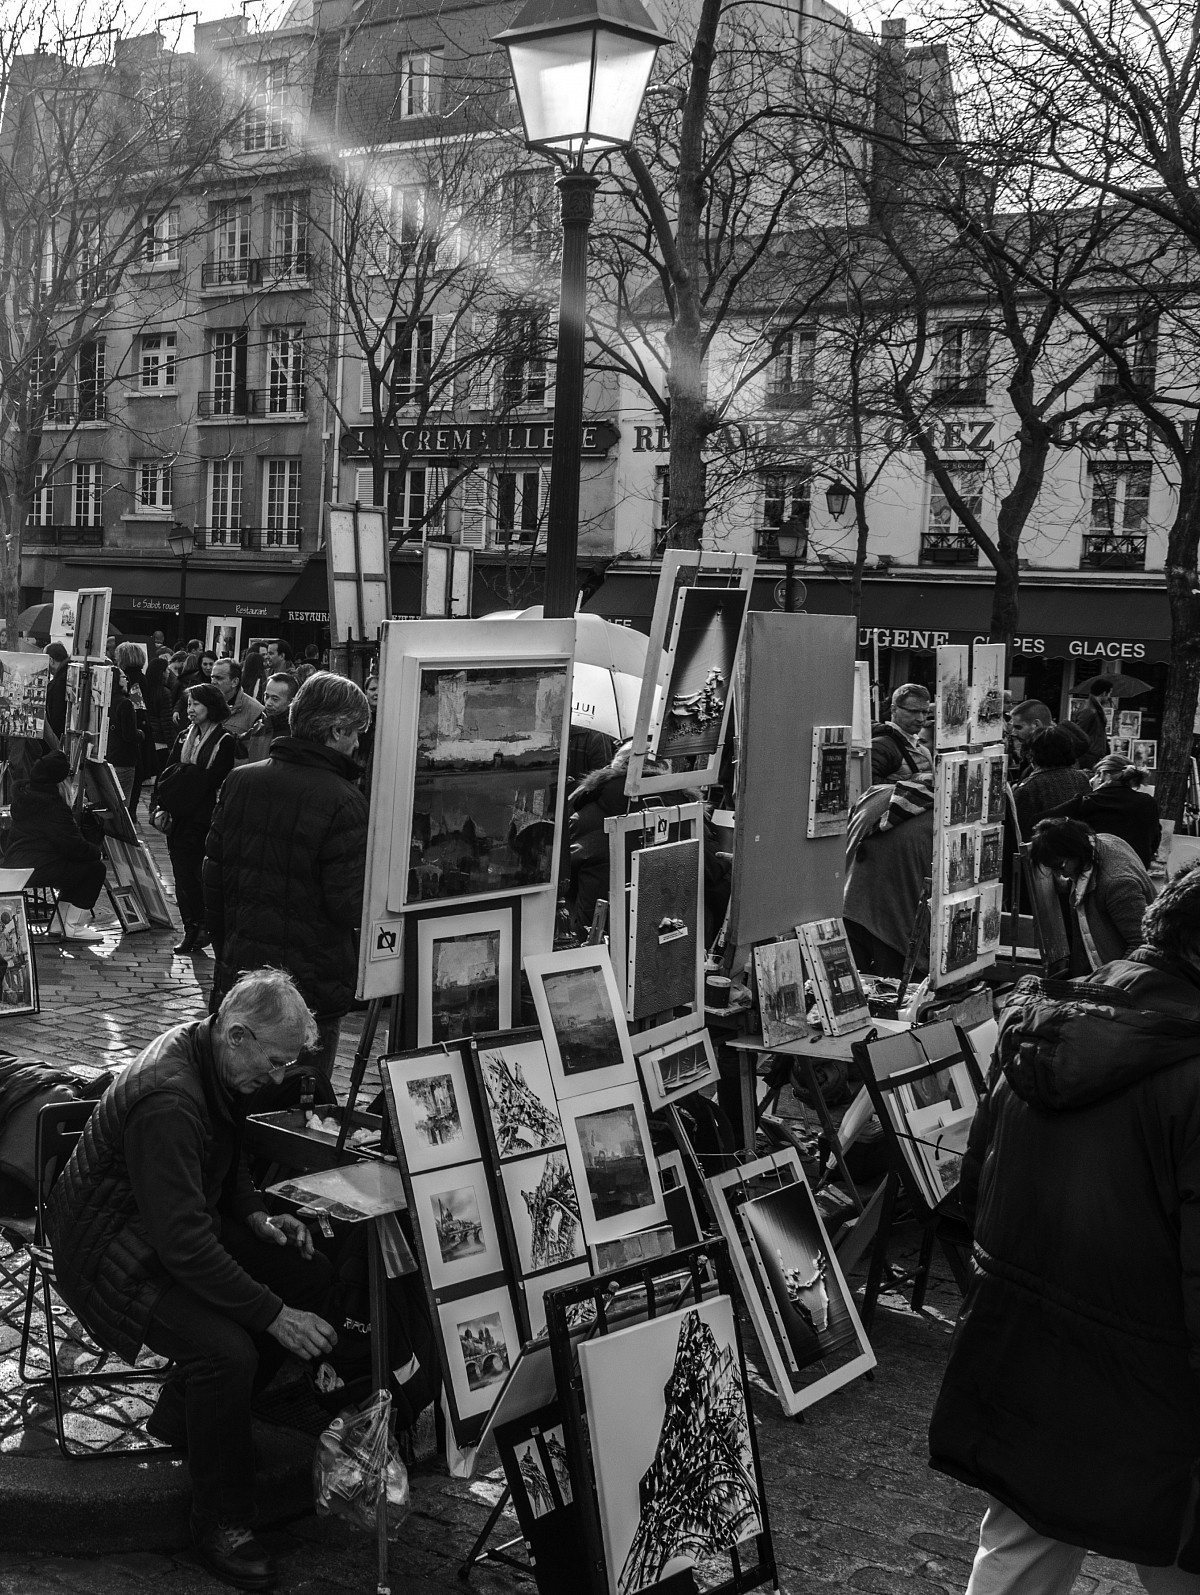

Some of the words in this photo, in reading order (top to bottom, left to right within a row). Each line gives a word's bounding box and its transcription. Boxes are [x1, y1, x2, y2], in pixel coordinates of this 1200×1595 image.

[132, 599, 141, 608] Le
[142, 600, 162, 609] Sabot
[235, 604, 267, 616] Restaurant
[1068, 640, 1146, 658] GLACES
